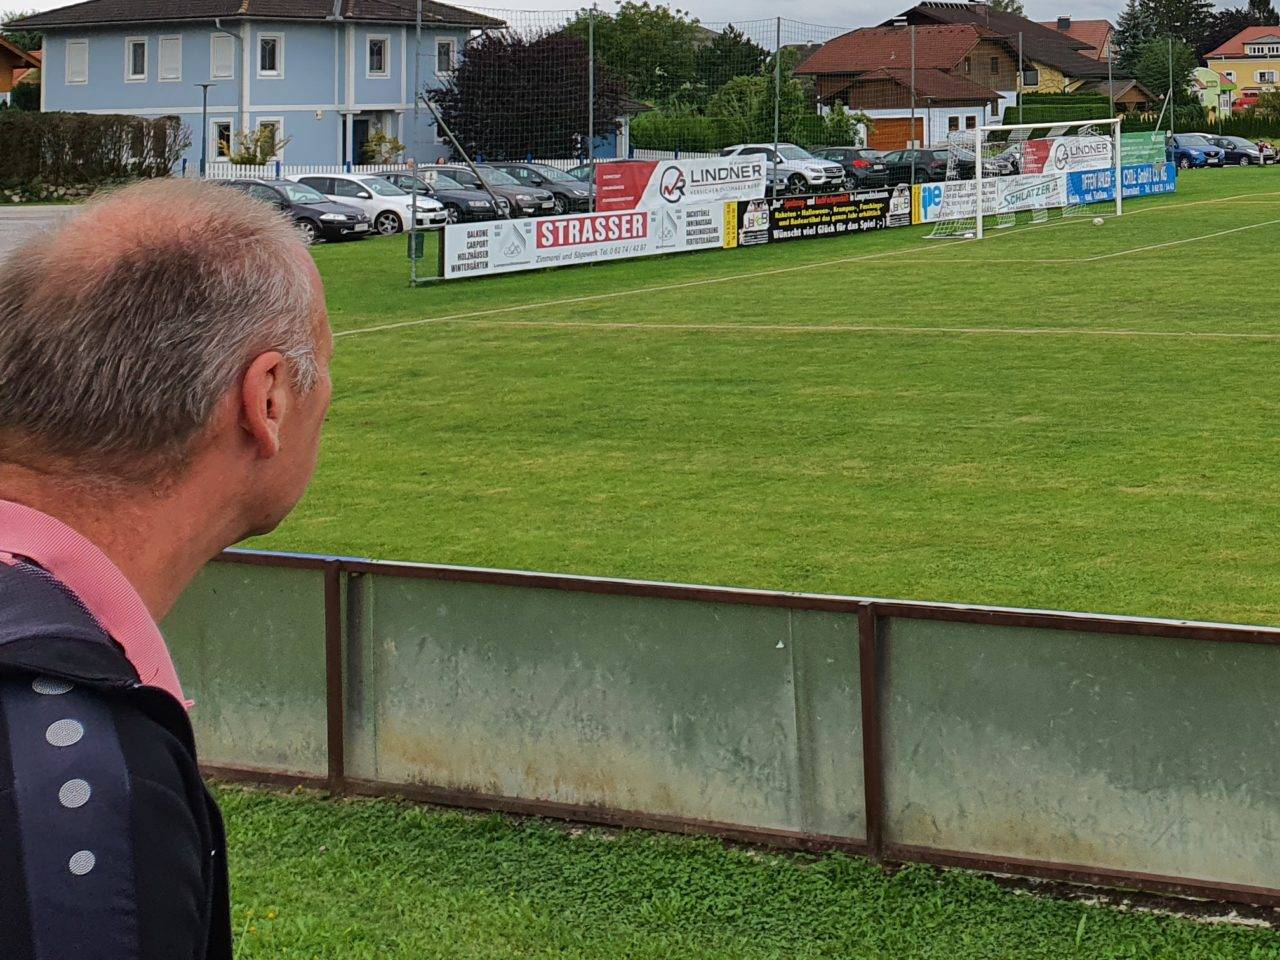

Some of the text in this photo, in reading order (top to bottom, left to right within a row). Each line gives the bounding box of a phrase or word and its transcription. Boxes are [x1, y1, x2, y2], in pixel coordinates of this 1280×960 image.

[1070, 143, 1108, 155] LINDNER
[690, 164, 762, 183] LINDNER
[1004, 184, 1050, 205] SCHLATZER
[467, 229, 488, 238] BALKONE
[541, 214, 644, 246] STRASSER
[773, 227, 801, 239] Wünscht
[802, 225, 816, 236] viel
[817, 223, 835, 234] Glück
[836, 221, 847, 231] für
[847, 221, 859, 231] das
[859, 218, 876, 229] Spiel
[467, 240, 488, 249] CARPORT
[457, 250, 488, 261] HOLZHÄUSER
[536, 253, 560, 263] Zimmerei
[562, 252, 572, 260] und
[574, 249, 599, 260] Sägewerk
[451, 260, 489, 272] WINTERGÄRTEN
